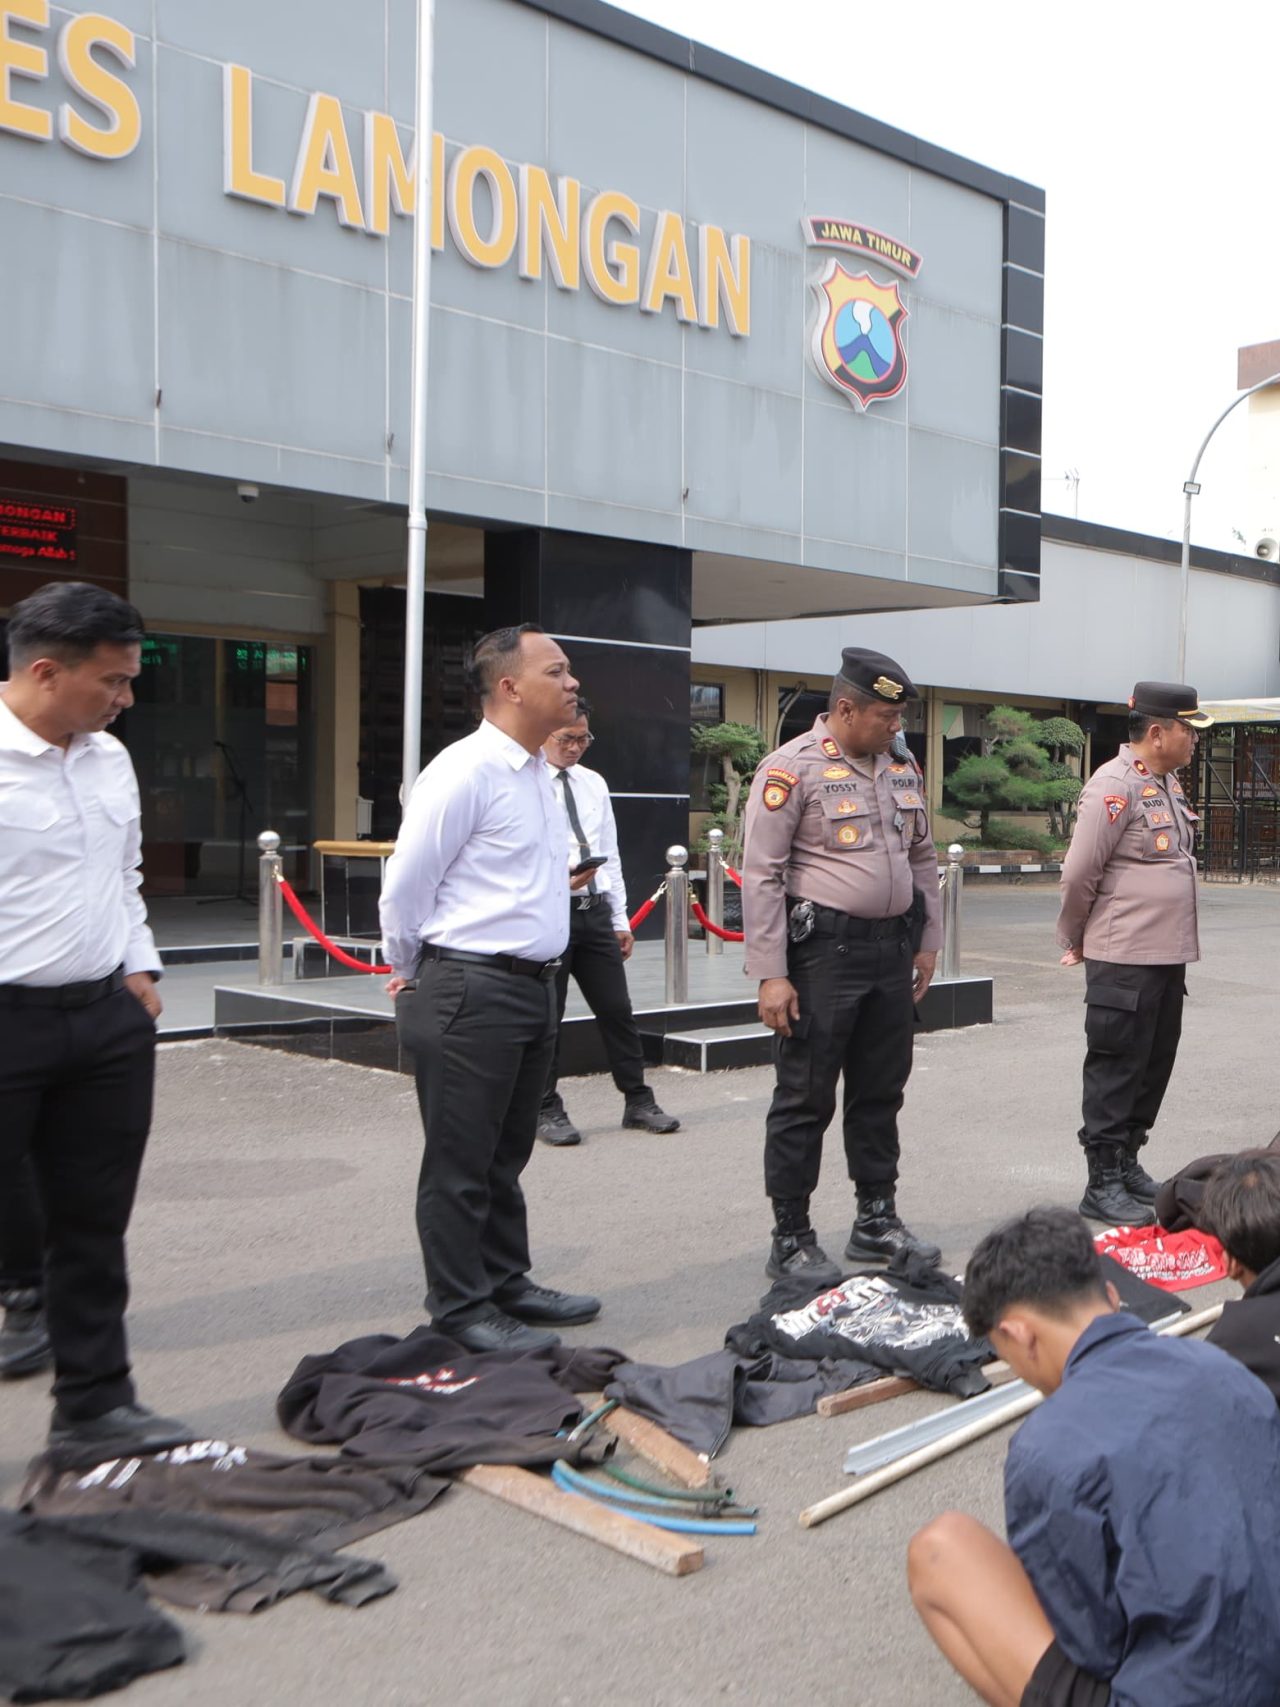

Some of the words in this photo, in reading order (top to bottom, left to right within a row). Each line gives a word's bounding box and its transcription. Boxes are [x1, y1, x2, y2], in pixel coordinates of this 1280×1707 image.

[223, 62, 753, 339] LAMONGAN
[821, 222, 863, 245] JAWA
[866, 231, 912, 267] TIMUR
[0, 505, 66, 523] ONGAN
[823, 783, 858, 794] YOSSY
[891, 778, 915, 788] POLRI
[1142, 798, 1166, 809] BUDI
